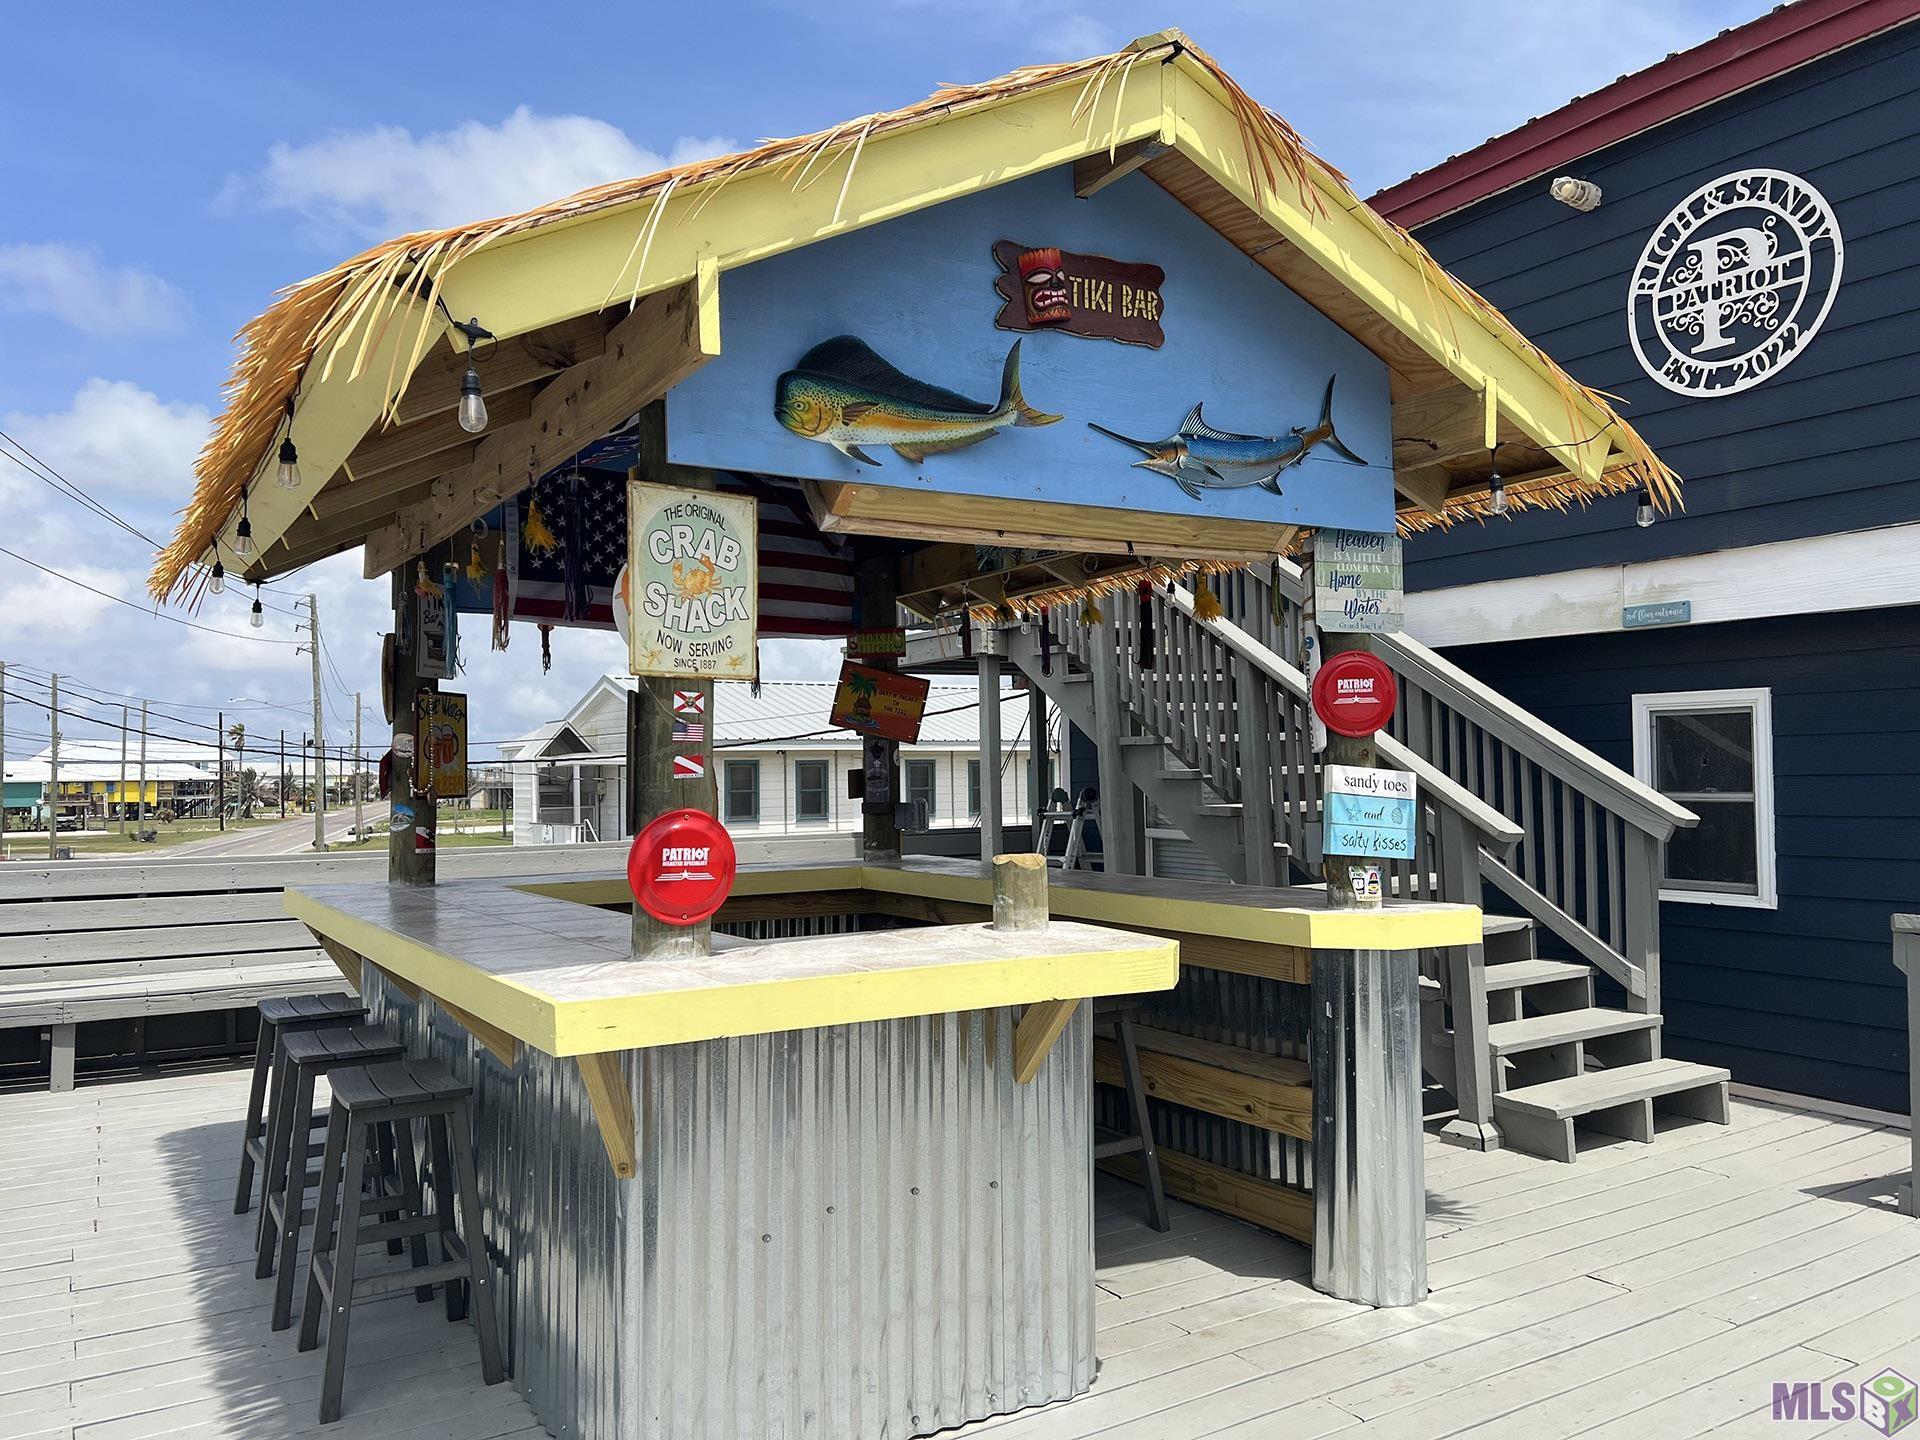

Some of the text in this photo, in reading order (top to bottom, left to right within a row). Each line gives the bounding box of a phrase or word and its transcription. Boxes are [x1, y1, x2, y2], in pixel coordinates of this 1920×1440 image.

[1636, 177, 1834, 293] RICH & SANDY
[1069, 276, 1159, 321] TIKI BAR
[1671, 263, 1790, 313] PATRIOT
[1660, 323, 1807, 391] EST. 2022
[663, 503, 726, 531] THE ORIGINAL
[648, 524, 742, 572] CRAB
[1335, 529, 1387, 553] Heaven
[1333, 551, 1383, 563] IS A LITTLE
[1336, 563, 1390, 574] CLOSER IN A
[1329, 570, 1362, 592] Home
[1356, 589, 1389, 599] BY THE
[643, 581, 750, 633] SHACK
[1344, 597, 1383, 620] Water
[656, 629, 733, 658] NOW SERVING
[673, 658, 717, 669] SINCE 1887
[1337, 678, 1375, 689] PATRIOT
[1344, 773, 1408, 793] sandy toes
[1363, 806, 1385, 822] and
[662, 847, 711, 861] PATRIOT
[1341, 831, 1407, 854] salty kisses
